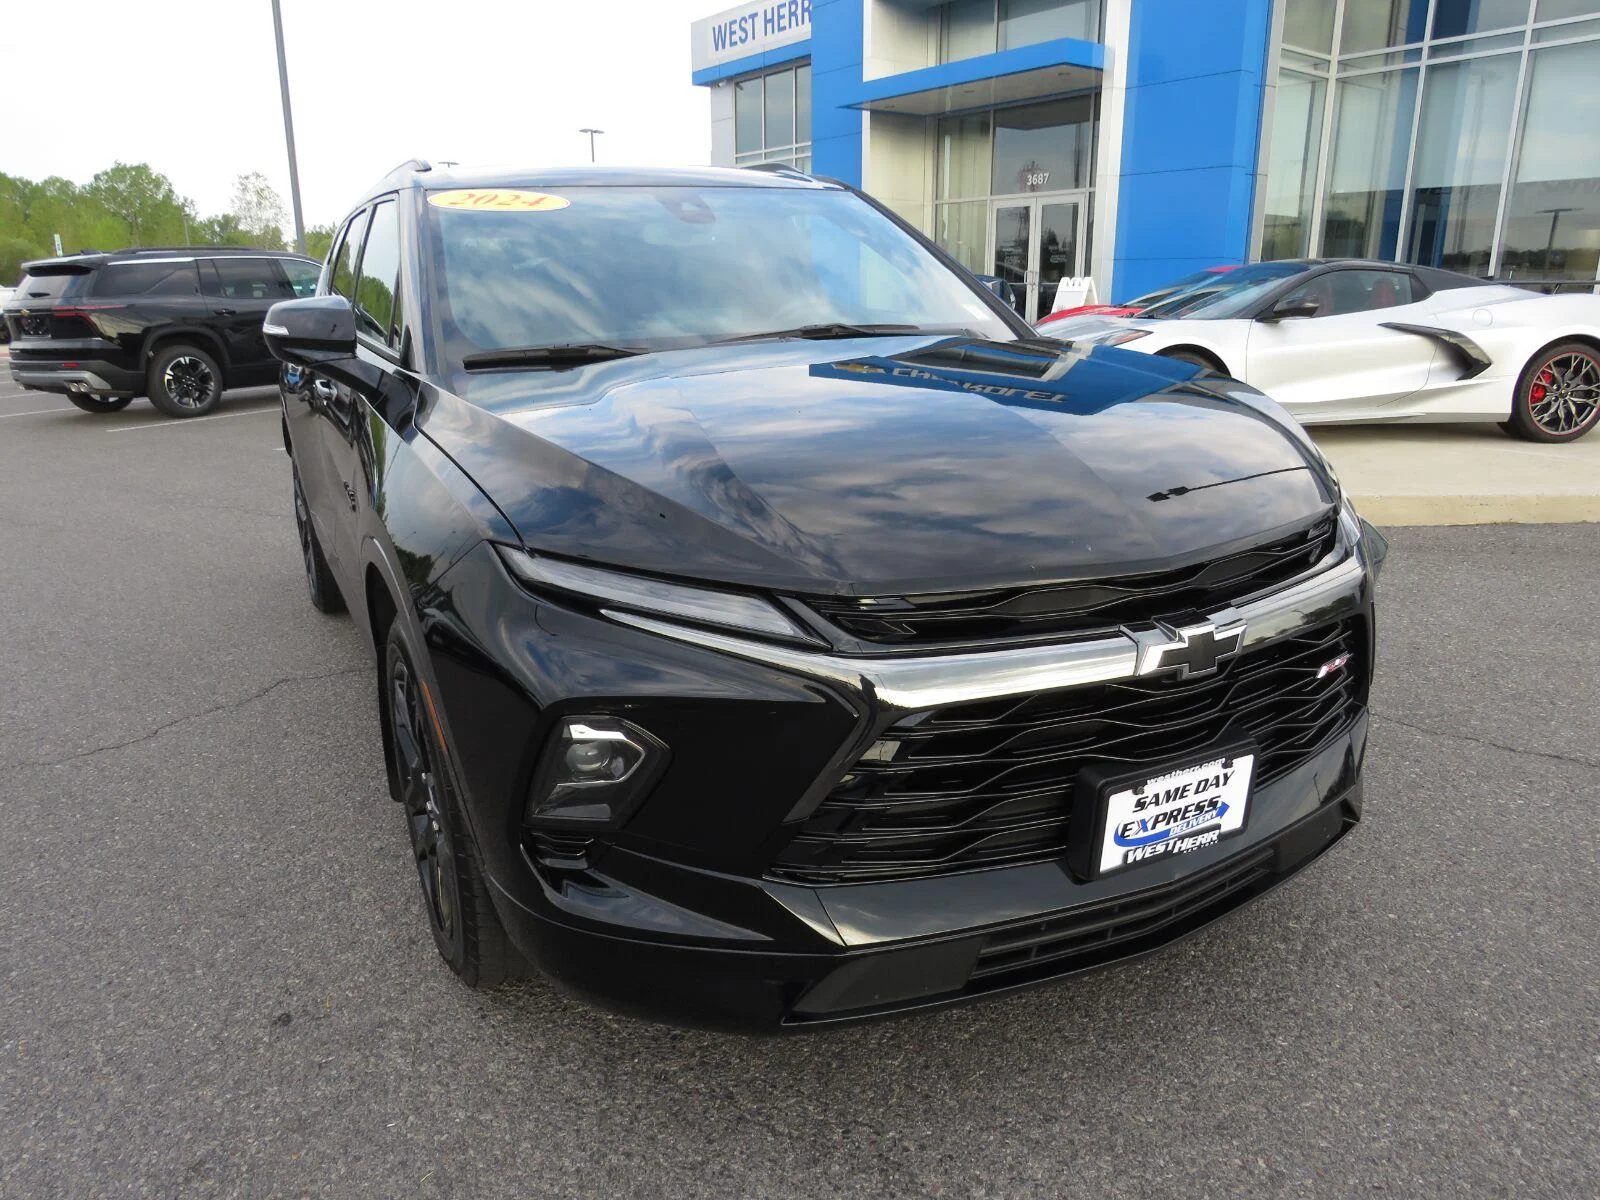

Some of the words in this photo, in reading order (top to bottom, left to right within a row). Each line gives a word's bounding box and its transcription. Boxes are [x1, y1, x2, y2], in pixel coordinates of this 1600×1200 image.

[712, 12, 759, 52] WEST
[763, 0, 812, 37] HERR
[1026, 172, 1049, 186] 3687
[447, 193, 548, 207] 2024
[1132, 783, 1193, 813] SAME
[1194, 770, 1236, 795] DAY
[1120, 795, 1222, 839] EXPRESS
[1169, 809, 1219, 837] DELIVERY
